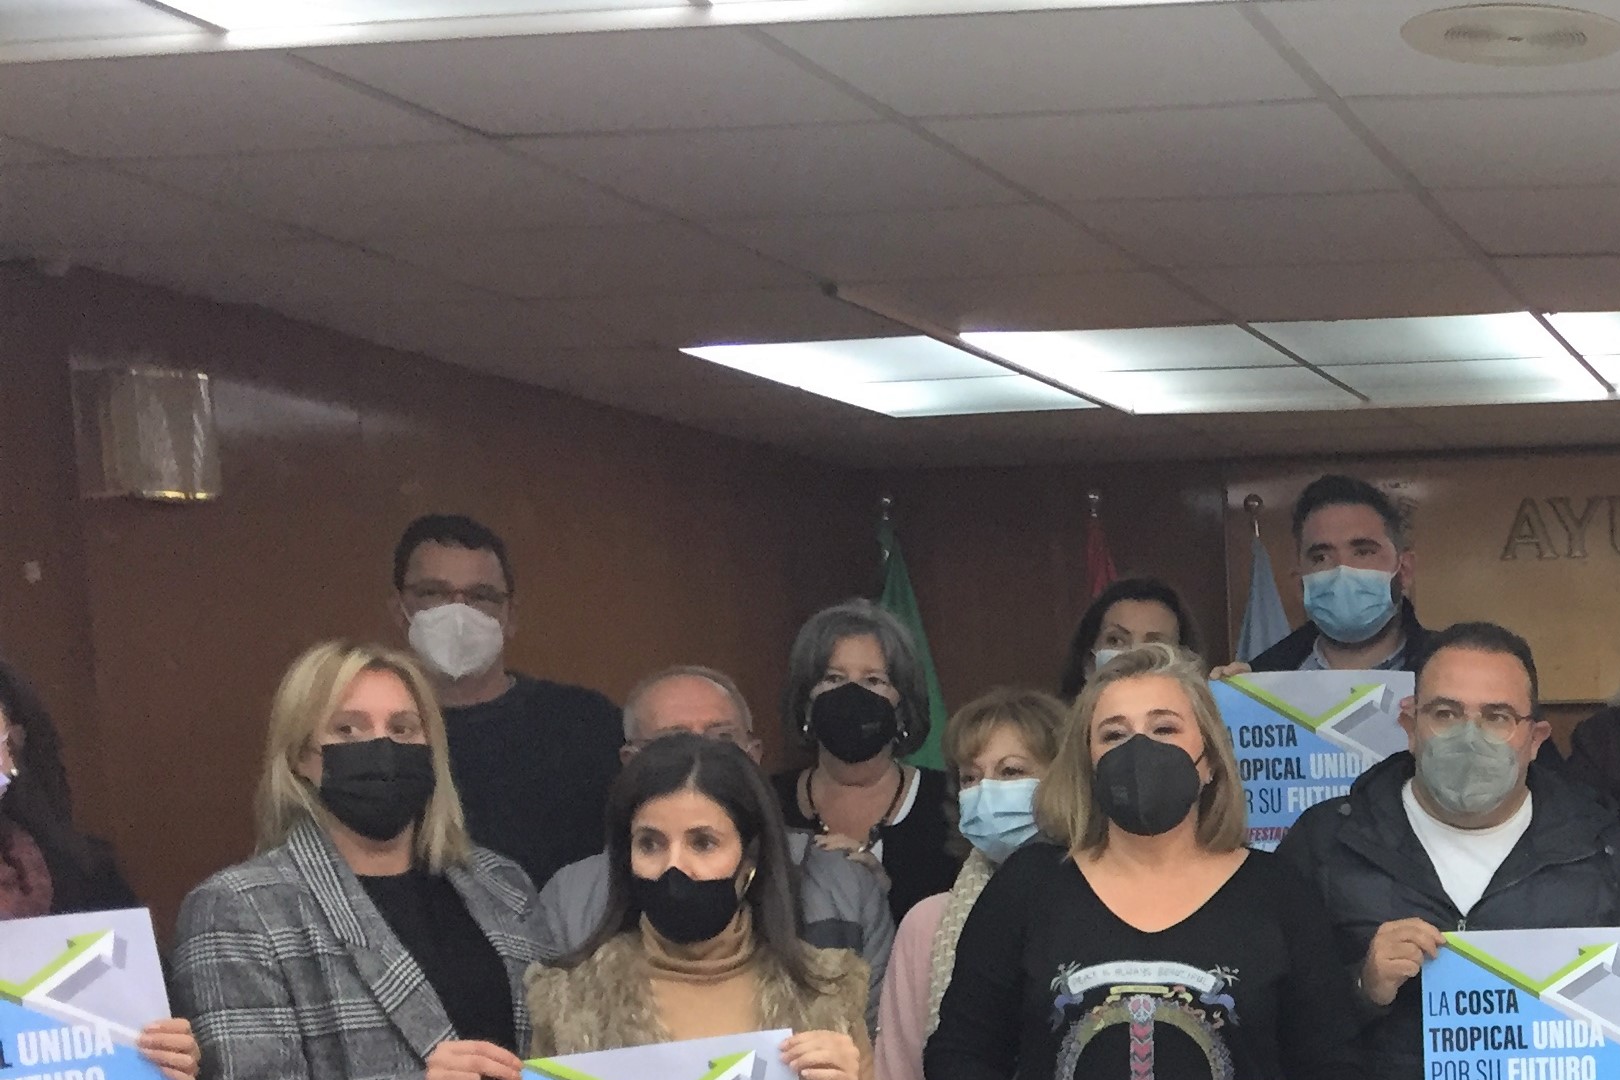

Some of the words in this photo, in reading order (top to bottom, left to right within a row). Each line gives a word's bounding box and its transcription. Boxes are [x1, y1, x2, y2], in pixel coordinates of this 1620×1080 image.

[1239, 724, 1298, 749] COSTA
[1239, 757, 1306, 782] OPICAL
[1259, 787, 1282, 814] SU
[1429, 992, 1448, 1015] LA
[1455, 989, 1517, 1014] COSTA
[17, 1024, 115, 1066] UNIDA
[1429, 1025, 1527, 1051] TROPICAL
[1533, 1019, 1604, 1048] UNIDA
